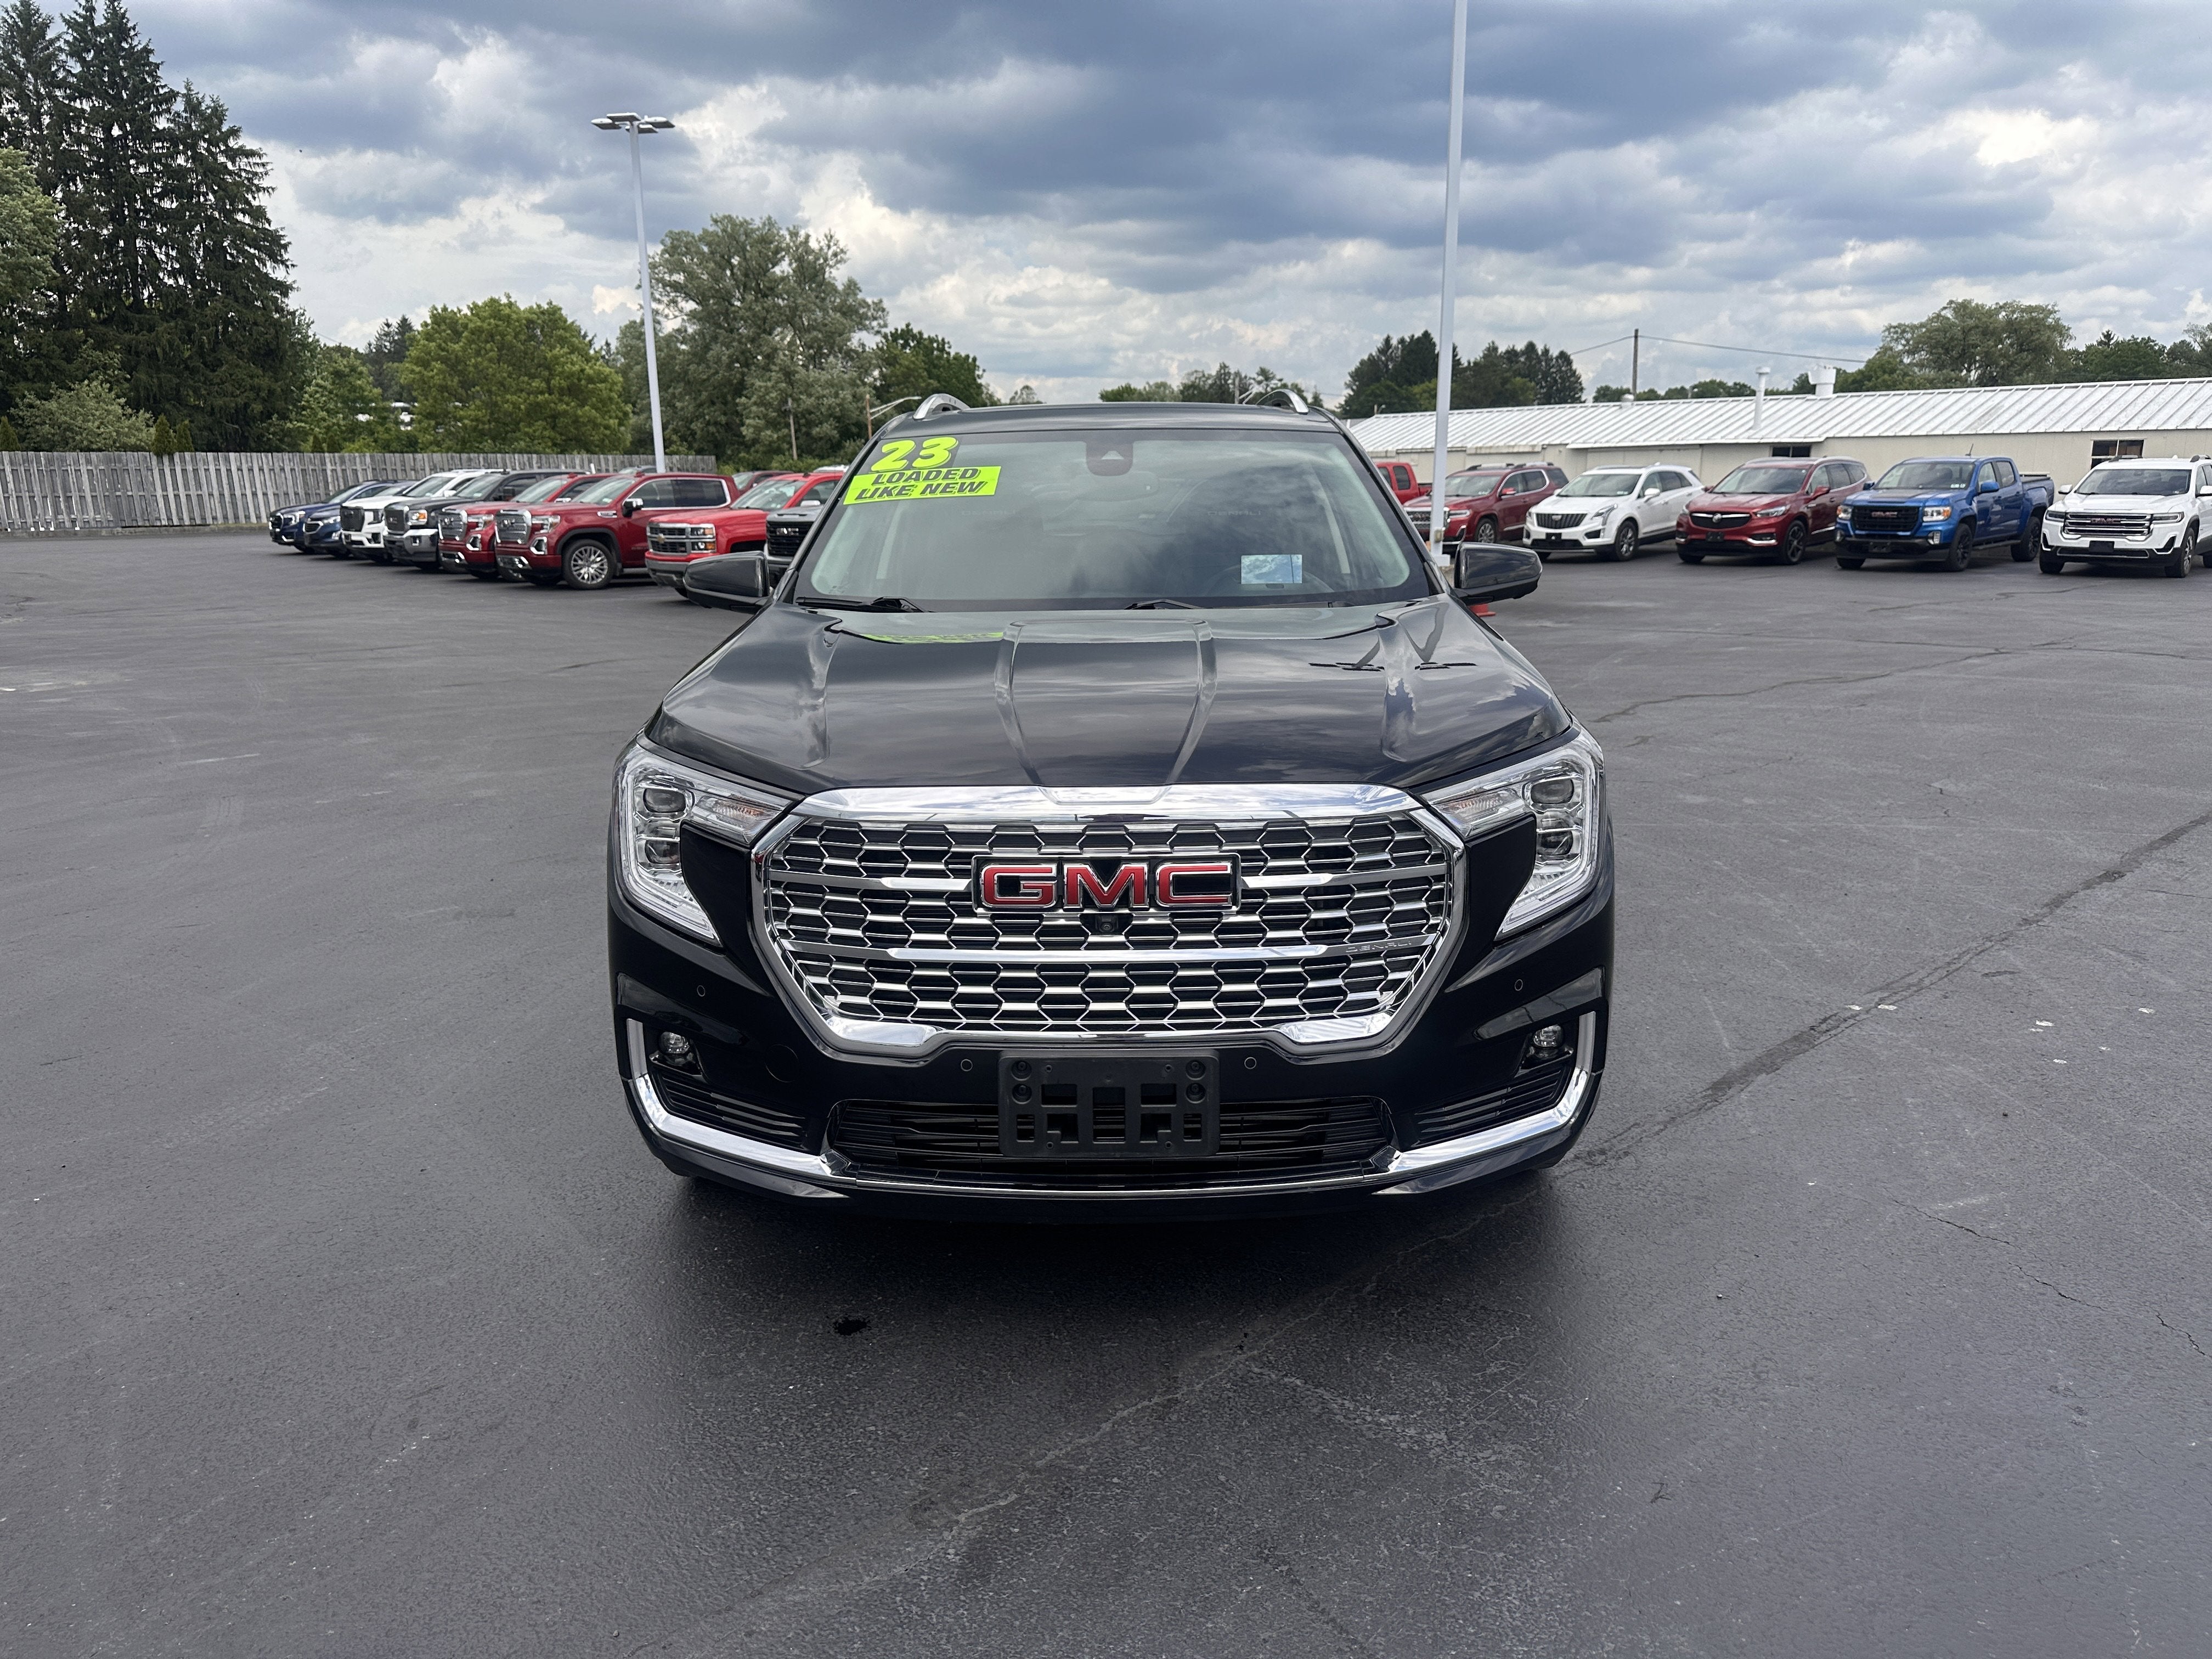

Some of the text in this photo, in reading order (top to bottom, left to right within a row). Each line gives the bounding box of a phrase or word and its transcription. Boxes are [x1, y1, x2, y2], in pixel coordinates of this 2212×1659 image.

[871, 437, 958, 472] 23
[871, 468, 981, 486] LOADED
[855, 481, 989, 501] LIKE NEW
[980, 862, 1233, 909] GMC
